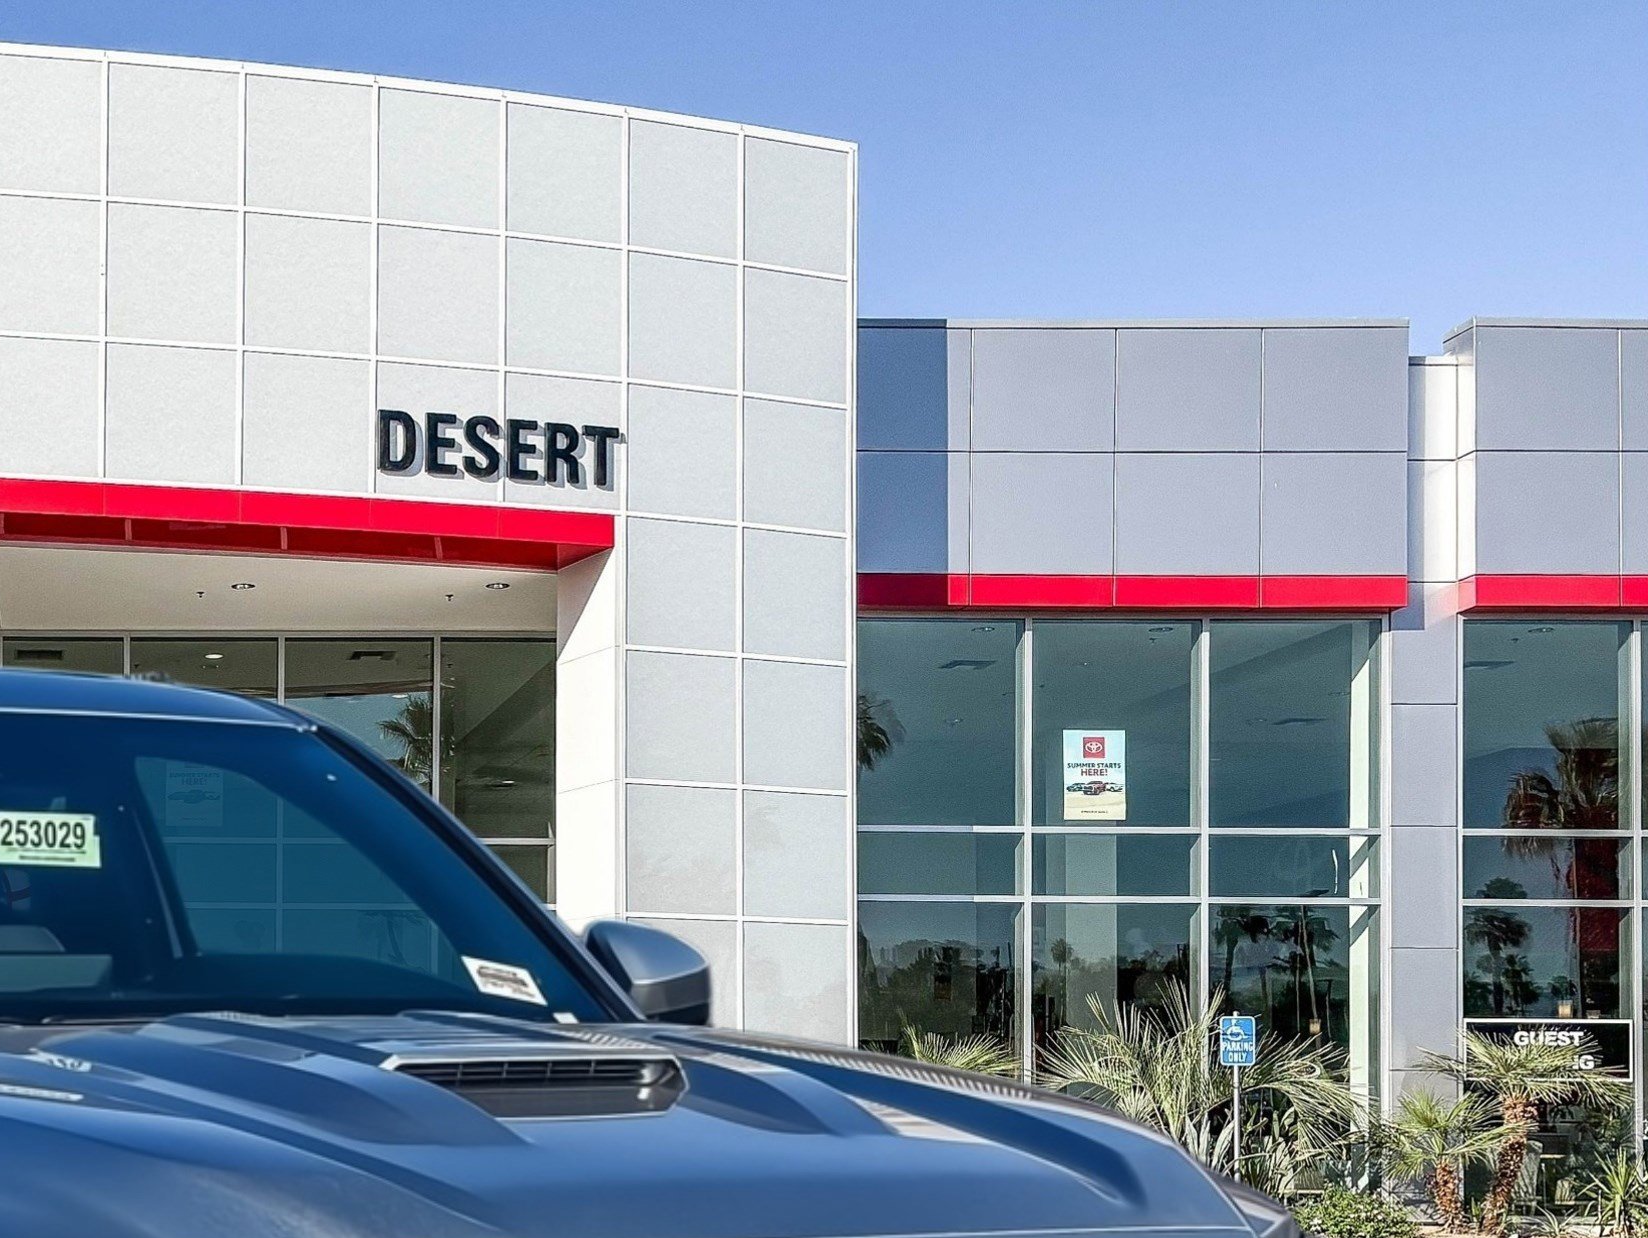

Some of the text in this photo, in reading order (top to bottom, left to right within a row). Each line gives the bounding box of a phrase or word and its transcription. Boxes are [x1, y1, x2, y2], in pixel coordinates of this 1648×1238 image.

[377, 409, 619, 486] DESERT
[1080, 768, 1108, 776] HERE!
[0, 819, 86, 849] 253029
[1513, 1030, 1585, 1046] GUEST
[1222, 1041, 1254, 1051] PARKING
[1228, 1052, 1247, 1062] ONLY
